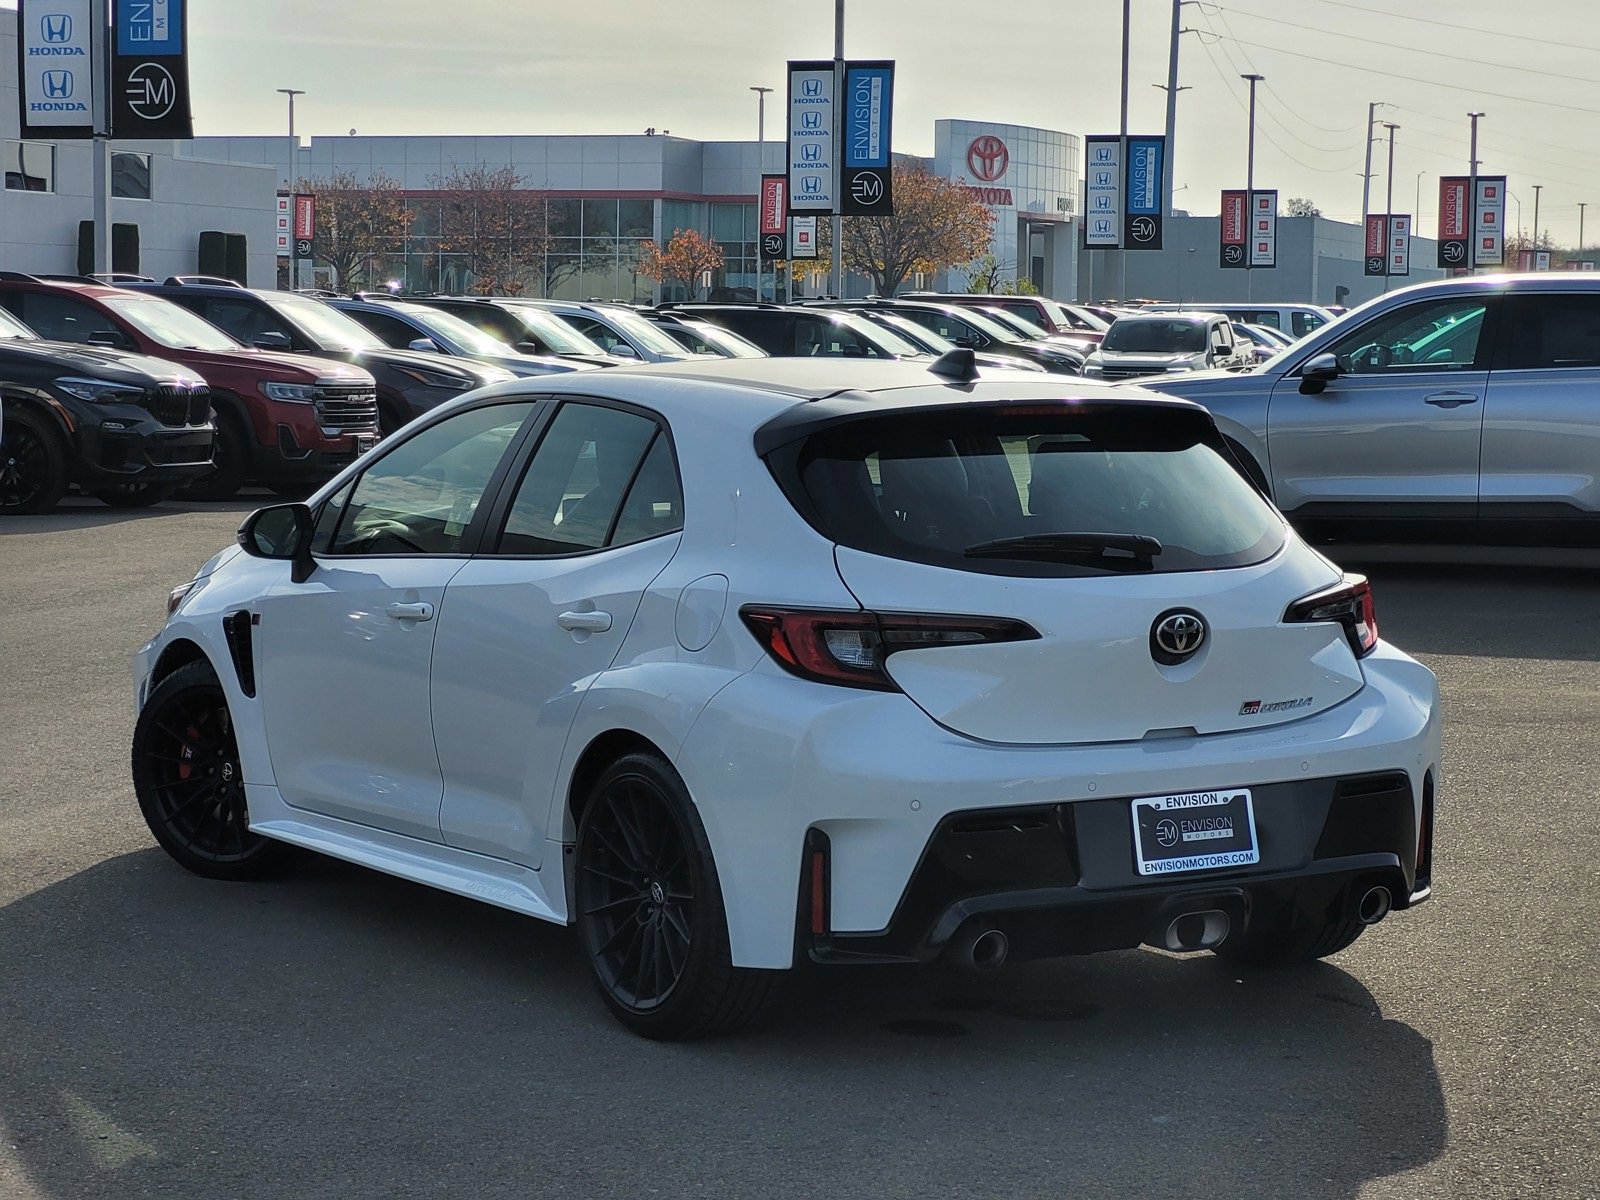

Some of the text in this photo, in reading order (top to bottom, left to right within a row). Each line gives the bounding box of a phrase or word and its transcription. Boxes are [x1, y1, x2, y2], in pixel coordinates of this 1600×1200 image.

[28, 47, 85, 56] HONDA
[30, 102, 87, 111] HONDA
[854, 76, 870, 160] ENVISION
[872, 84, 880, 153] MOTORS
[1134, 146, 1147, 208] ENVISION
[298, 200, 306, 236] ENVISION
[767, 182, 776, 229] ENVISION
[1227, 197, 1235, 240] ENVISION
[1446, 185, 1456, 235] ENVISION
[1370, 220, 1378, 254] ENVISION
[1166, 793, 1218, 808] ENVISION
[1181, 817, 1233, 833] ENVISION
[1145, 853, 1254, 873] ENVISIONMOTORS.COM
